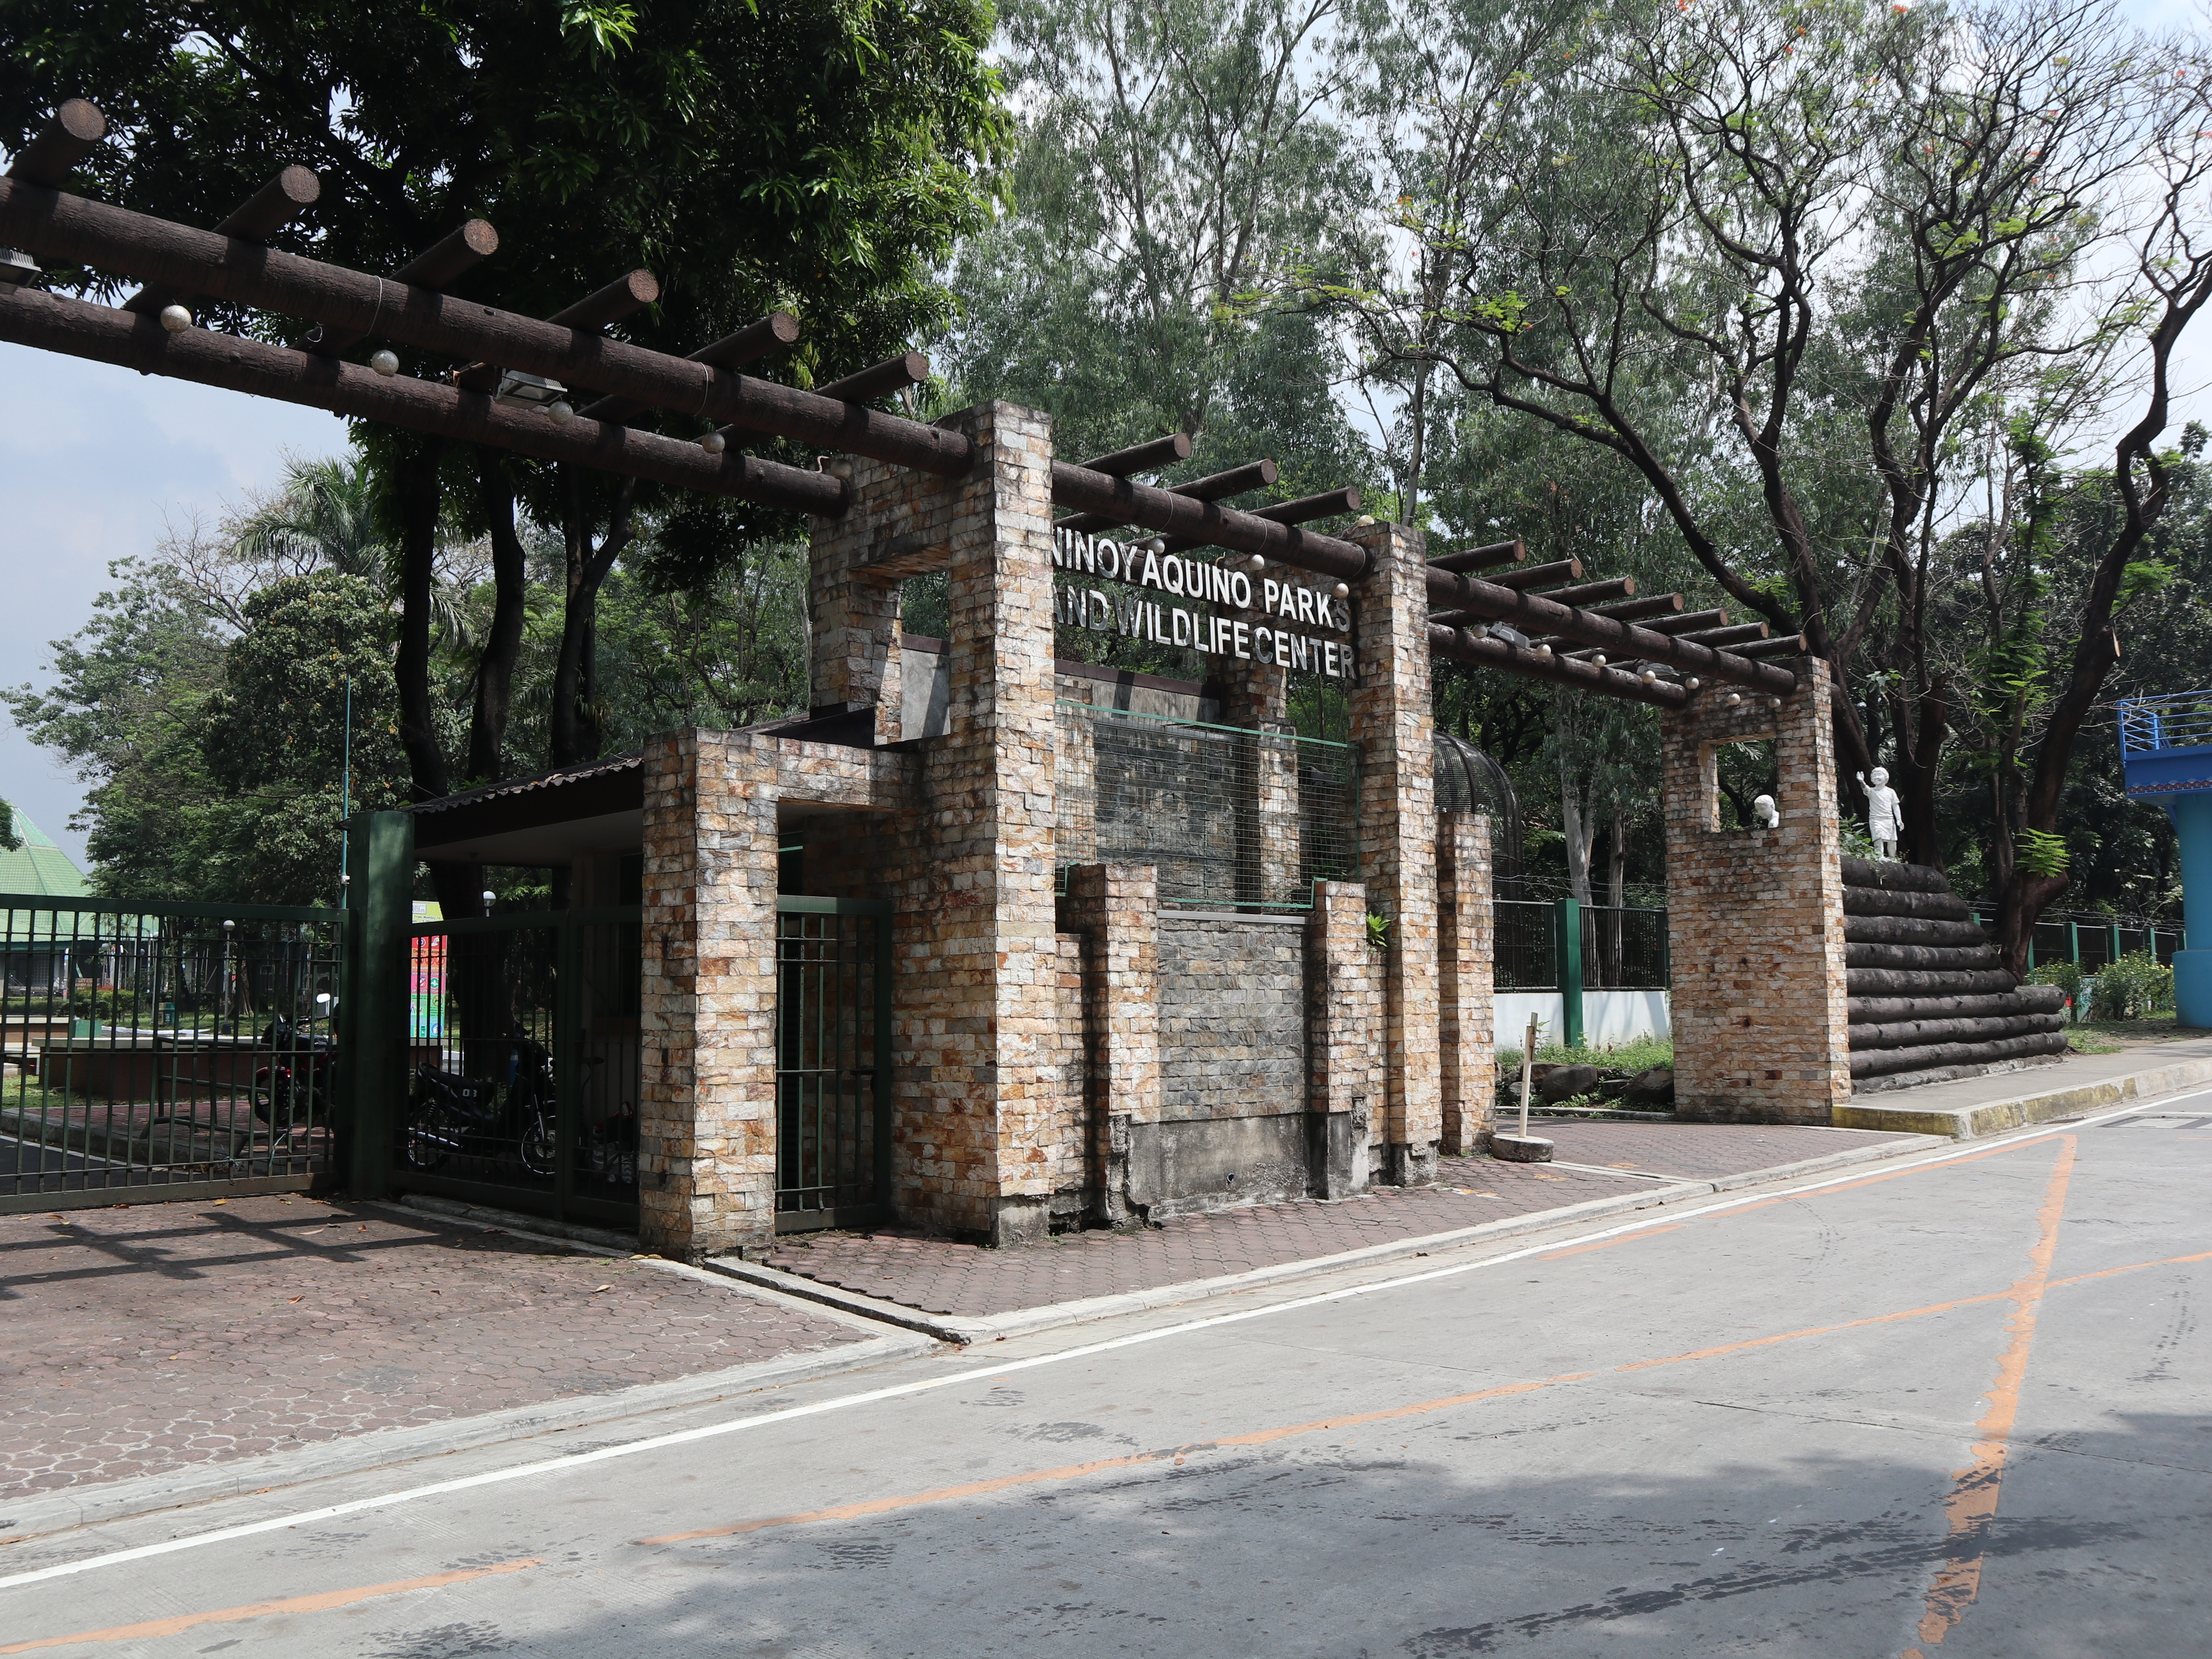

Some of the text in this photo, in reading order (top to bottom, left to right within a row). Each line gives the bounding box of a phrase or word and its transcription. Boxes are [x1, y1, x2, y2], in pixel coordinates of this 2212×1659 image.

[1141, 549, 1251, 609] AQUINO
[1264, 578, 1351, 633] PARKS
[1114, 595, 1251, 660] WILDLIFE
[1254, 626, 1357, 680] CENTER
